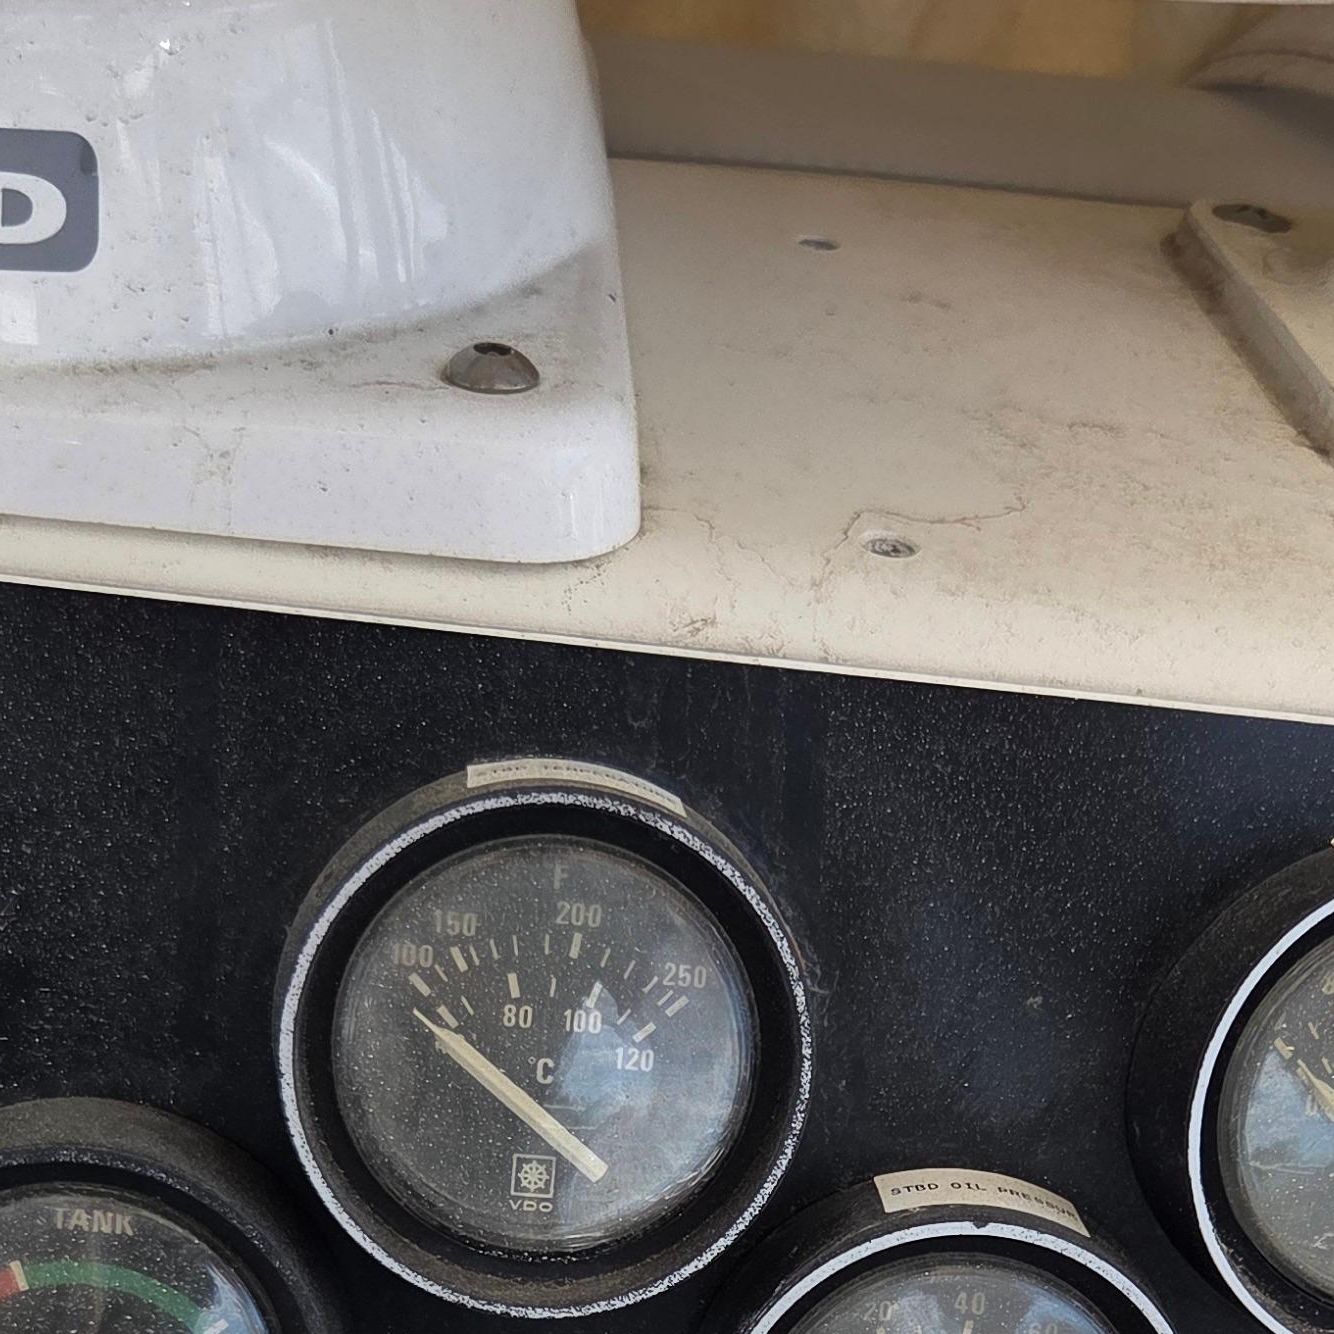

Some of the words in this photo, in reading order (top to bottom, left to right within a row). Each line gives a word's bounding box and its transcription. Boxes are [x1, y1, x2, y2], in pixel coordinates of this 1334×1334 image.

[434, 909, 478, 937] 150
[555, 901, 603, 929] 200
[392, 942, 435, 968] 100
[663, 962, 708, 989] 250
[502, 1004, 534, 1029] 80
[564, 1008, 603, 1034] 100
[615, 1047, 656, 1073] 120
[890, 1182, 940, 1197] STBD
[950, 1181, 987, 1192] OIL
[508, 1199, 553, 1212] VDO
[55, 1207, 135, 1236] TANK
[954, 1291, 987, 1316] 40
